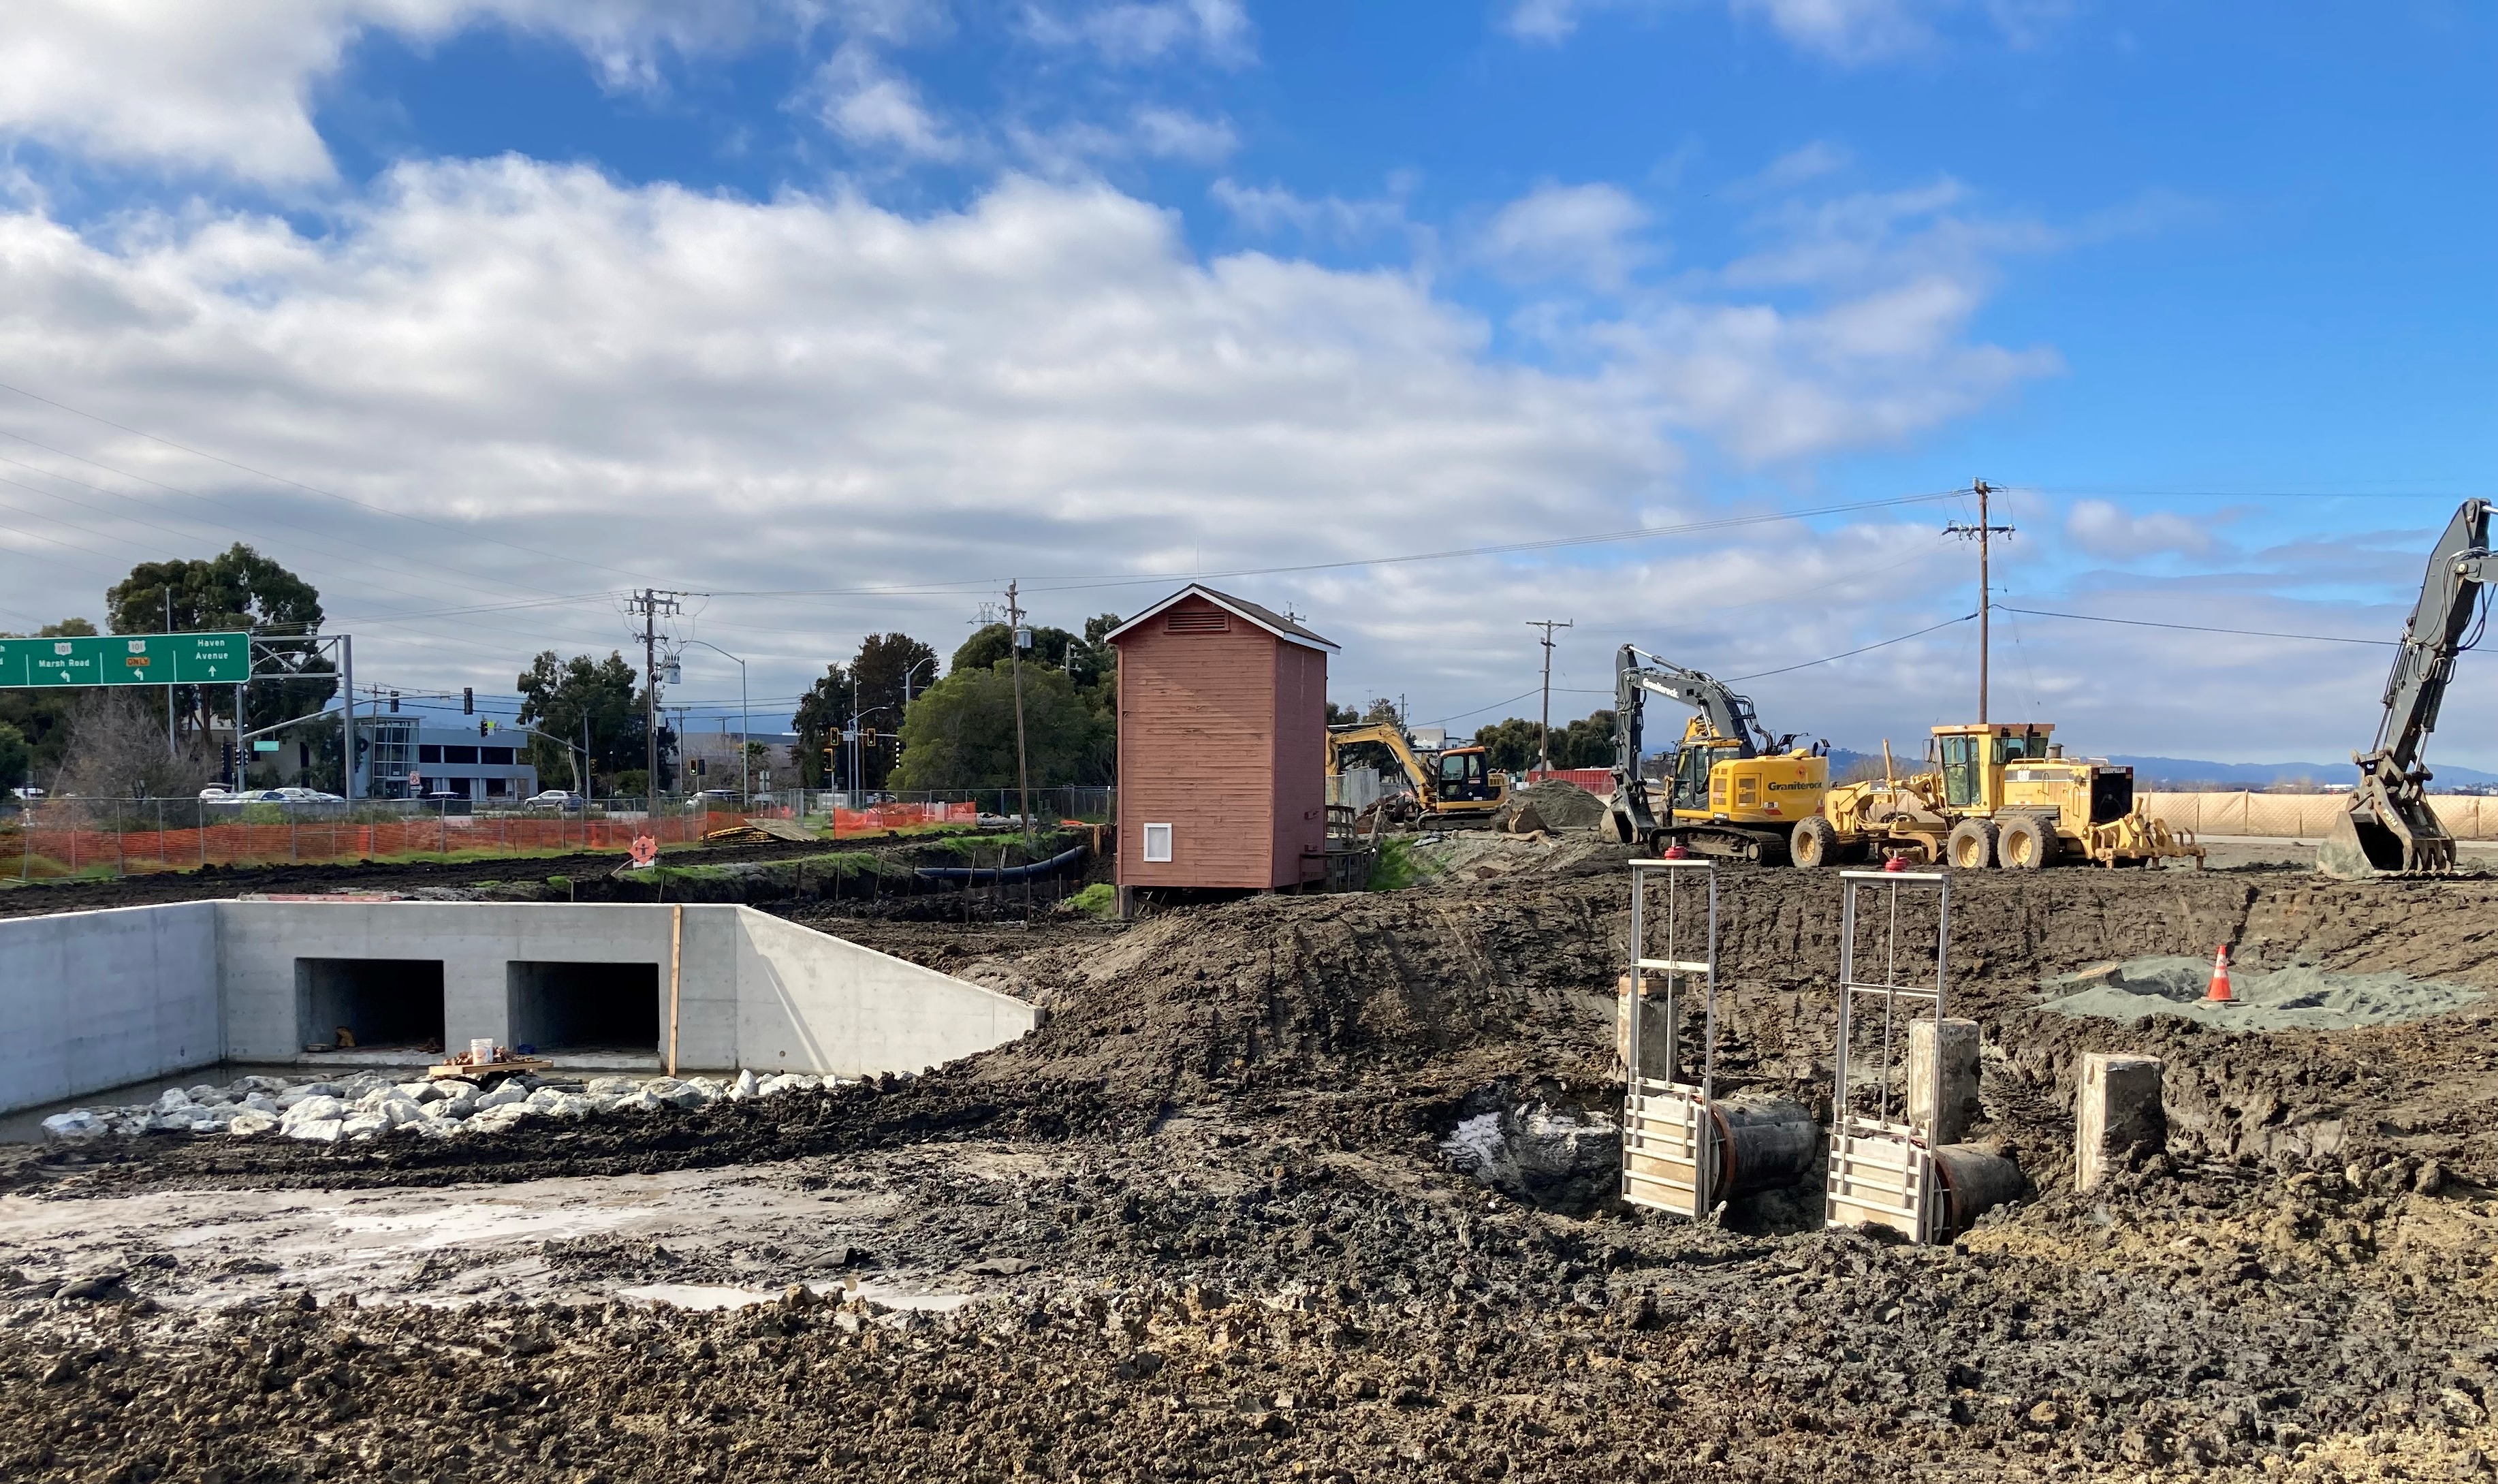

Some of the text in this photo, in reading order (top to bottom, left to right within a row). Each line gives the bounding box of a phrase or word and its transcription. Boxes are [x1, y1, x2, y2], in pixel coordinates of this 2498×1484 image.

[197, 639, 225, 647] Haven
[195, 652, 229, 660] Avenue
[39, 659, 90, 667] Marsh Road
[1643, 678, 1679, 699] Graniterock
[1768, 781, 1822, 791] Graniterock
